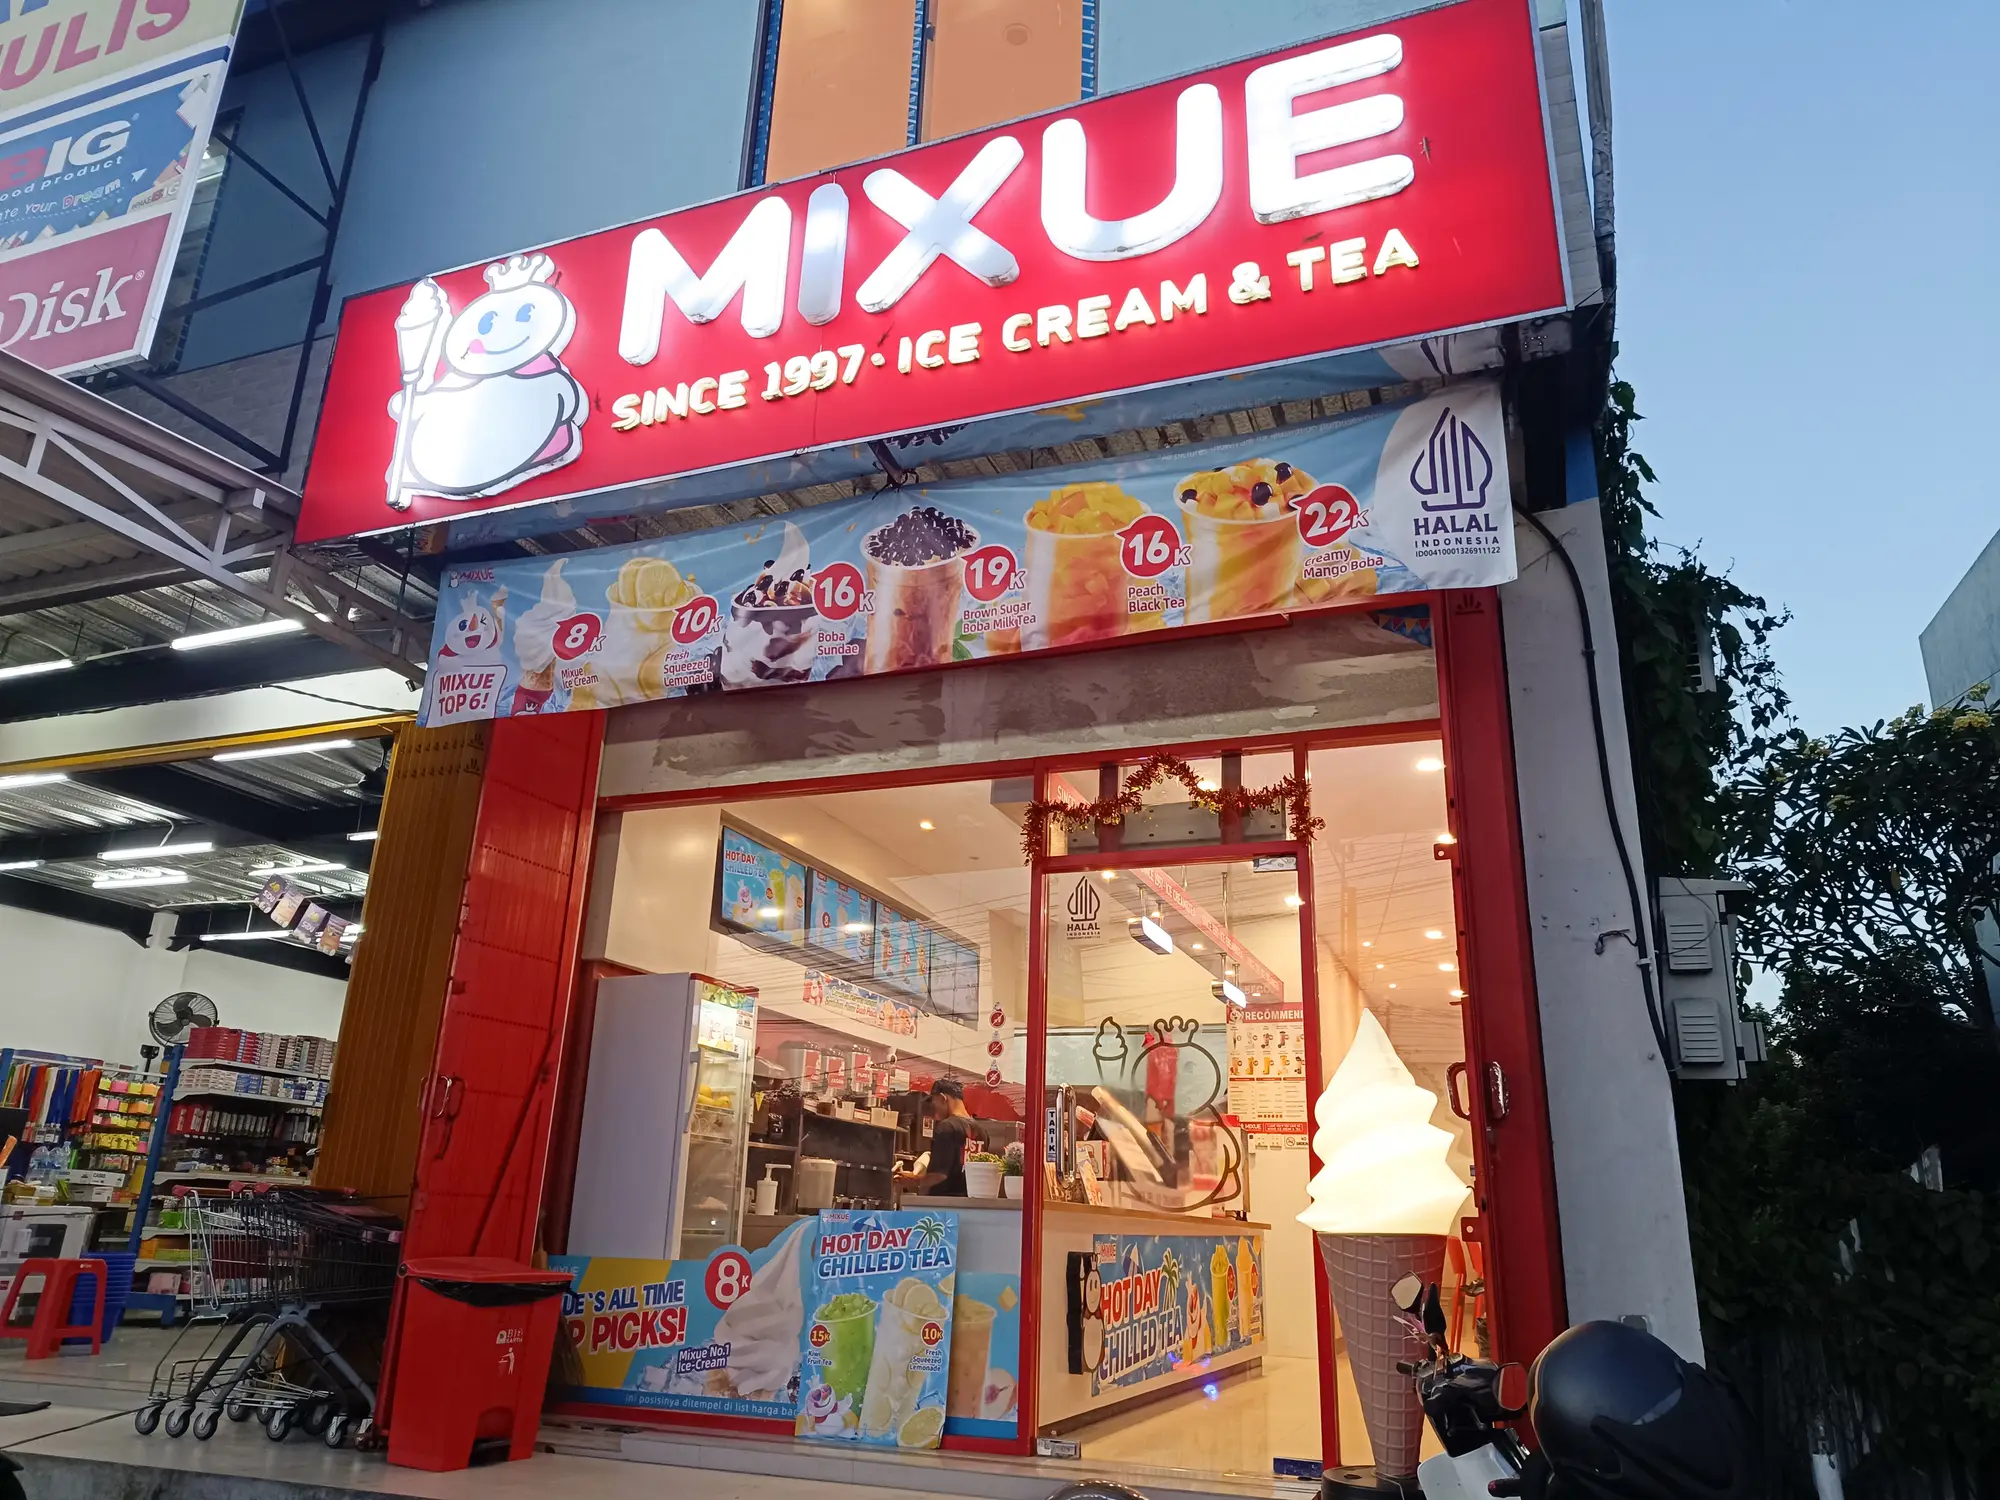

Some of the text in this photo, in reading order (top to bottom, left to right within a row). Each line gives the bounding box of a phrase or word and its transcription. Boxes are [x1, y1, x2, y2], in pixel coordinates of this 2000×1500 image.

[0, 0, 190, 91] ULIS
[0, 120, 131, 192] BIG
[40, 155, 123, 191] product
[62, 178, 121, 210] Dream
[618, 33, 1415, 366] MIXUE
[610, 369, 750, 432] SINCE
[897, 321, 983, 374] ICE
[1001, 273, 1208, 352] CREAM
[1228, 261, 1272, 305] &
[1287, 228, 1419, 291] TEA
[1413, 513, 1498, 536] HALAL
[1414, 536, 1499, 548] INDONESIA
[1415, 546, 1501, 558] ID00410001326911122
[459, 568, 494, 581] MIXUE
[1303, 556, 1383, 579] Mango Boba
[1128, 583, 1164, 598] Peach
[963, 601, 1031, 620] Brown Sugar
[1128, 597, 1185, 613] Black Tea
[963, 614, 1036, 634] Boba Milk Tea
[818, 631, 845, 643] Boba
[665, 650, 690, 662] Fresh
[817, 643, 859, 656] Sundae
[561, 667, 584, 680] Mixue
[663, 658, 710, 675] Squeezed
[439, 673, 496, 695] MIXUE
[561, 674, 599, 689] Ice Cream
[663, 672, 714, 687] Lemonade
[438, 692, 489, 718] TOP 6!
[725, 850, 756, 864] HOT DAY
[1067, 923, 1100, 931] HALAL
[820, 1228, 913, 1255] HOT DAY
[819, 1247, 950, 1277] CHILLED TEA
[608, 1287, 638, 1309] ALL
[643, 1280, 685, 1306] TIME
[1101, 1269, 1162, 1325] HOT DAY
[591, 1307, 687, 1351] PICKS!
[811, 1330, 830, 1342] 15K
[923, 1328, 943, 1340] 10K
[1159, 1307, 1183, 1351] TEA
[679, 1344, 730, 1362] Mixue No.1
[822, 1358, 832, 1366] Tea
[912, 1356, 942, 1365] Squeezed
[678, 1358, 726, 1373] Ice-Cream
[639, 1395, 680, 1407] posisinya
[682, 1398, 721, 1412] ditempel
[724, 1401, 732, 1411] di
[735, 1402, 749, 1413] list
[752, 1404, 779, 1416] harga
